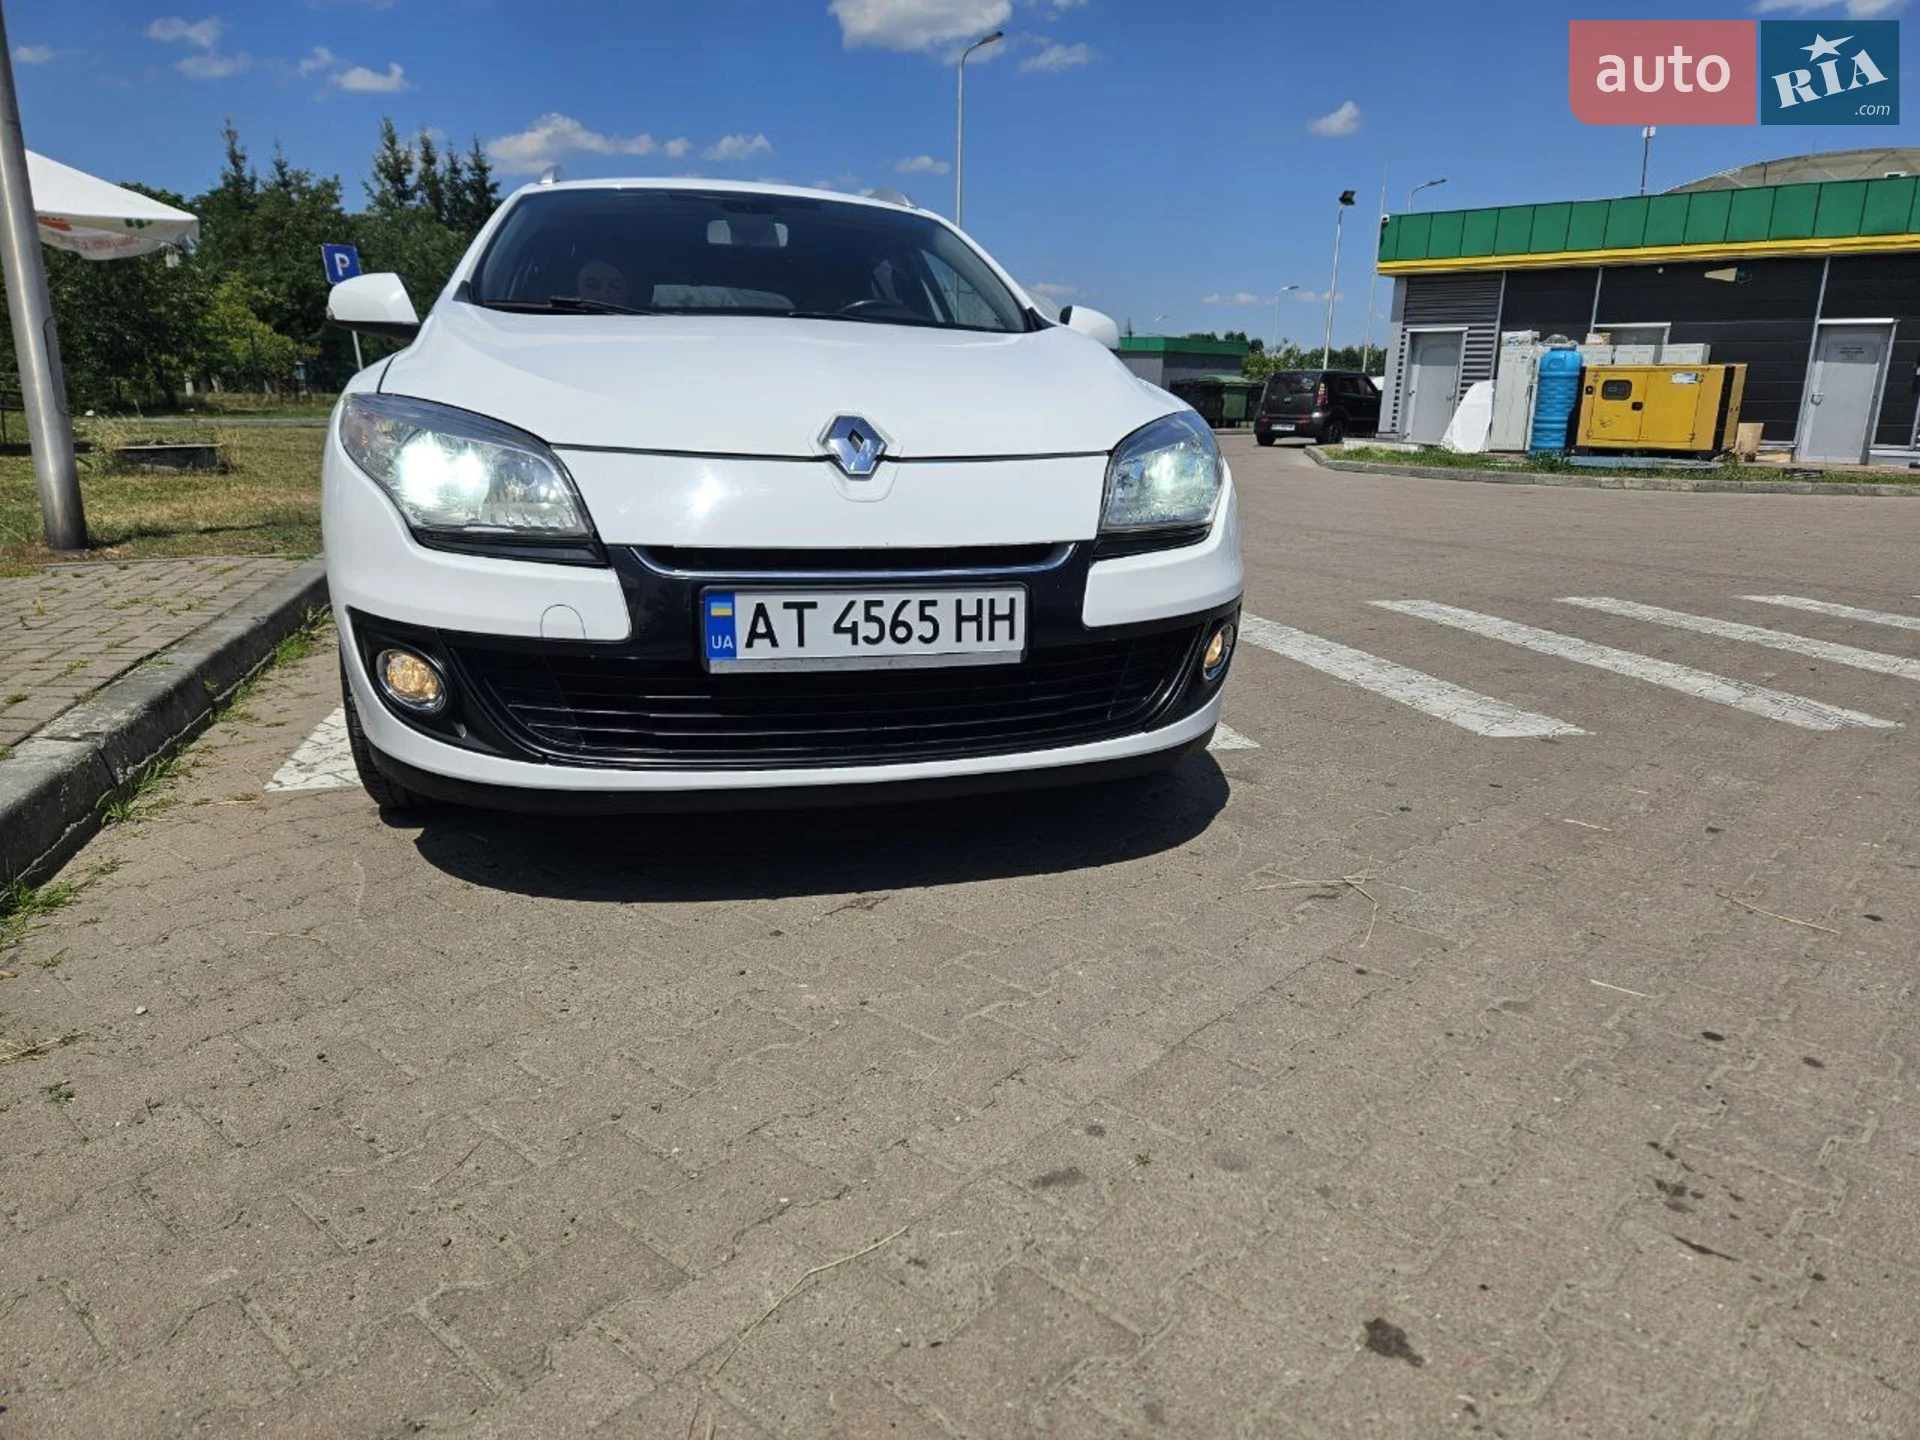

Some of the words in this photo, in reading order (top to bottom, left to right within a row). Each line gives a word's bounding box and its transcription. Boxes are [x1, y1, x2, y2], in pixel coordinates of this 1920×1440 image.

[334, 253, 350, 276] P
[745, 601, 818, 648] AT
[833, 599, 940, 646] 4565
[954, 597, 1016, 643] HH
[711, 634, 734, 649] UA
